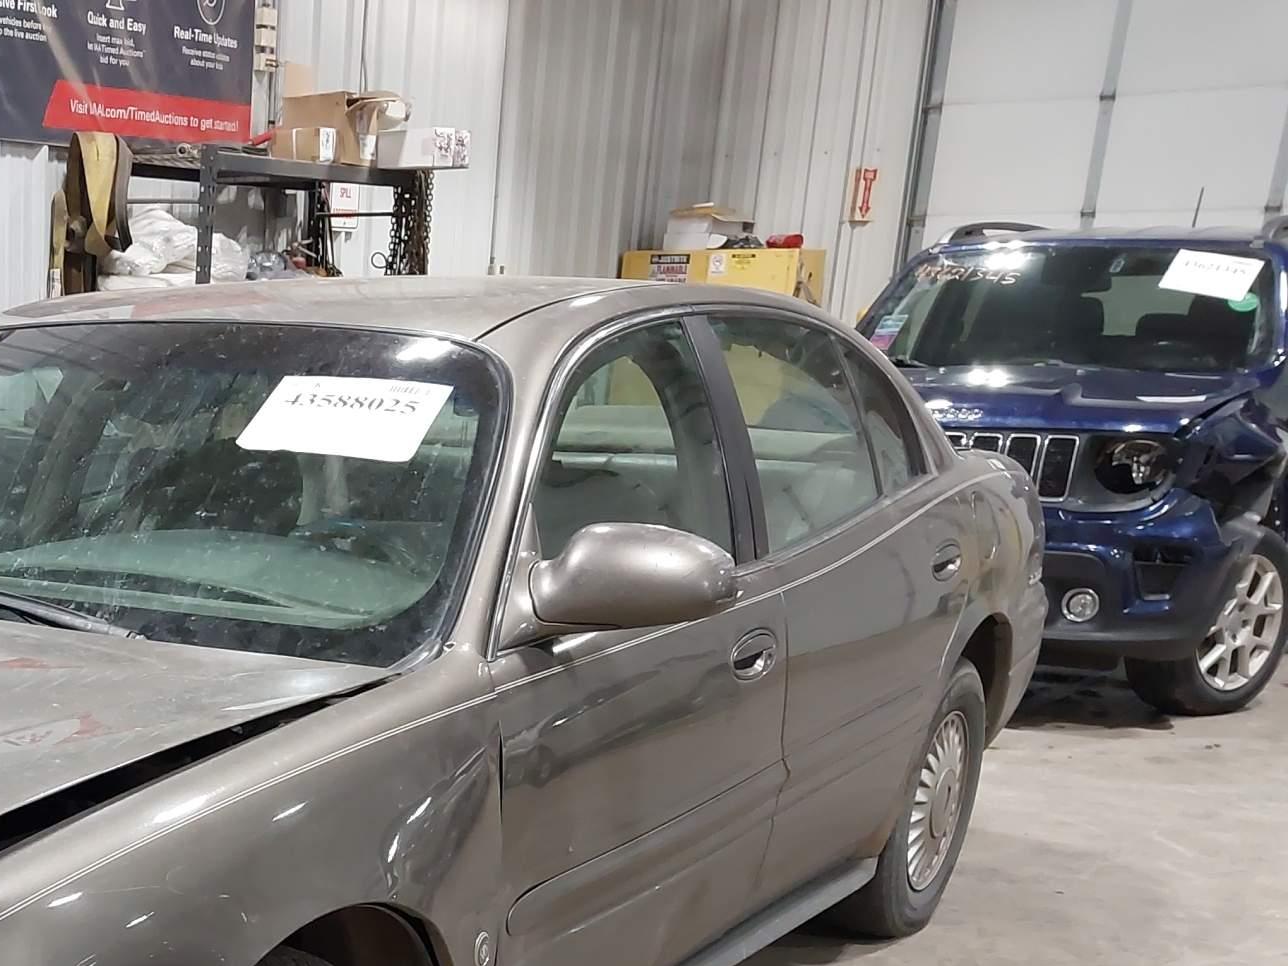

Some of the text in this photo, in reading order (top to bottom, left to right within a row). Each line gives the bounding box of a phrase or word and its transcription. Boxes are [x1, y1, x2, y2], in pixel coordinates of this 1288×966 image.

[4, 28, 13, 37] the
[14, 29, 24, 38] live
[87, 11, 146, 35] Quick and Easy
[174, 25, 238, 48] Real-Time Updates
[70, 99, 88, 114] Visit
[190, 116, 198, 127] to
[201, 118, 213, 131] get
[283, 392, 421, 414] 43588025
